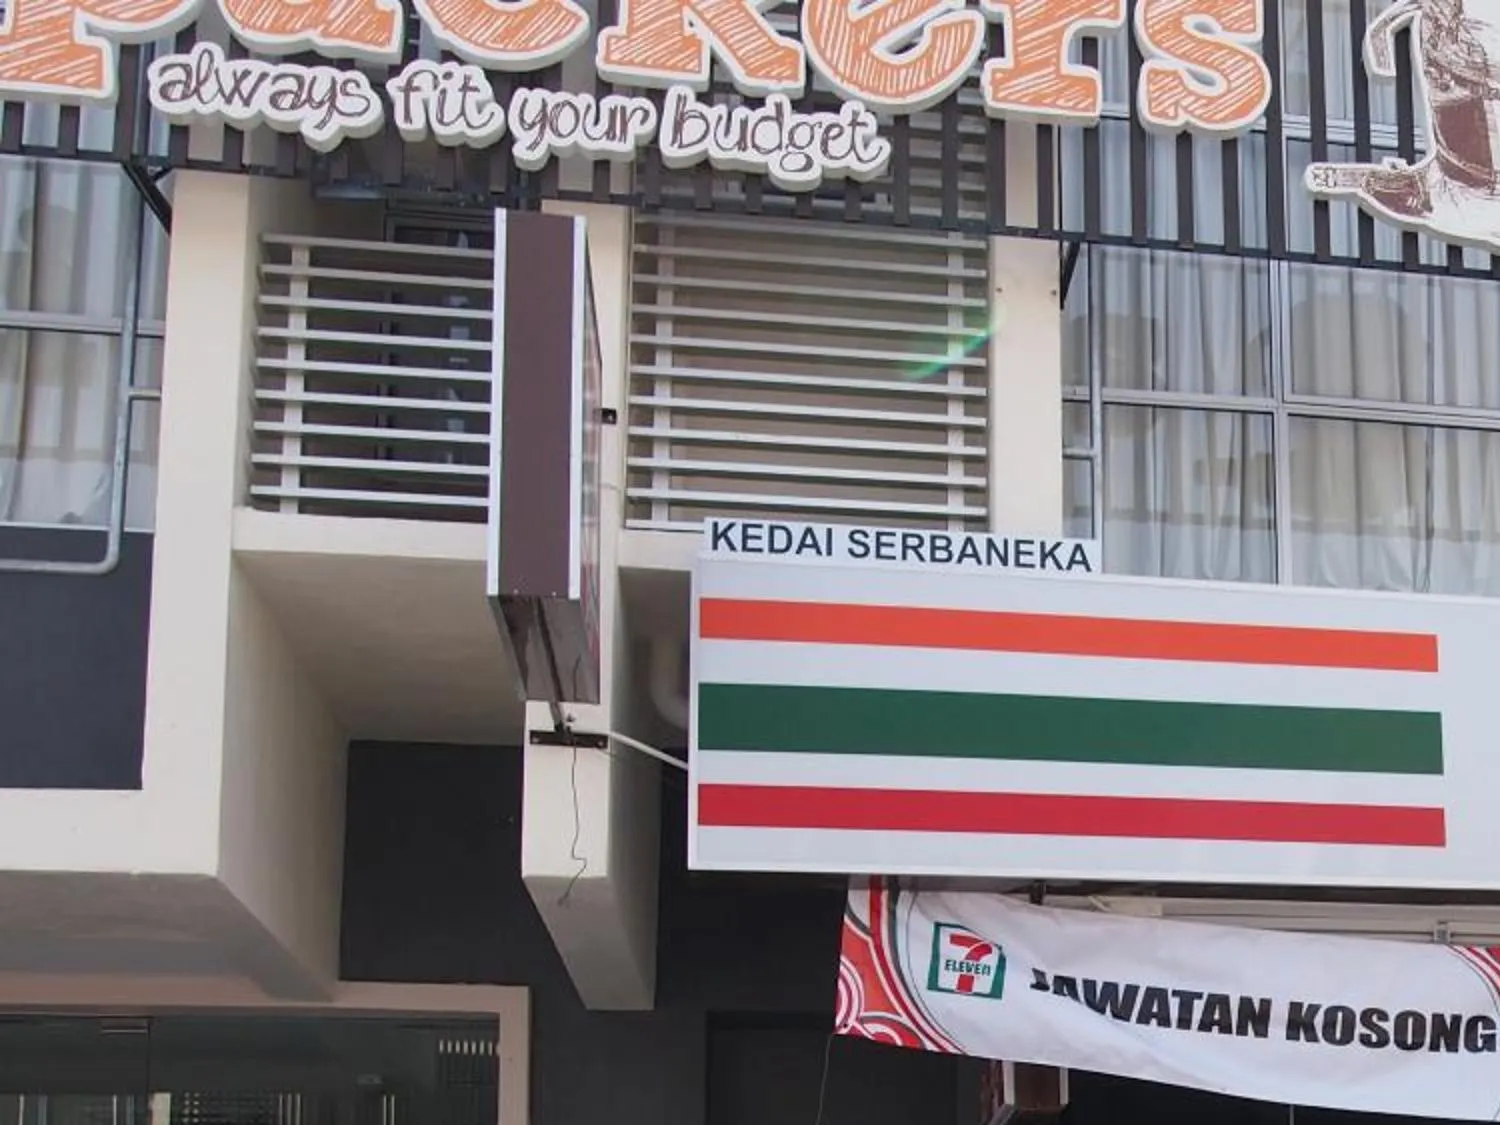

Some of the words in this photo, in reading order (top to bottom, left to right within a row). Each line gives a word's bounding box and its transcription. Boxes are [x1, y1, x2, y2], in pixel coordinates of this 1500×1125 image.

[157, 47, 374, 129] always
[396, 69, 497, 128] fit
[517, 92, 651, 151] your
[673, 92, 886, 173] budget
[711, 521, 834, 557] KEDAI
[847, 528, 1092, 573] SERBANEKA
[1286, 1001, 1498, 1053] KOSONG
